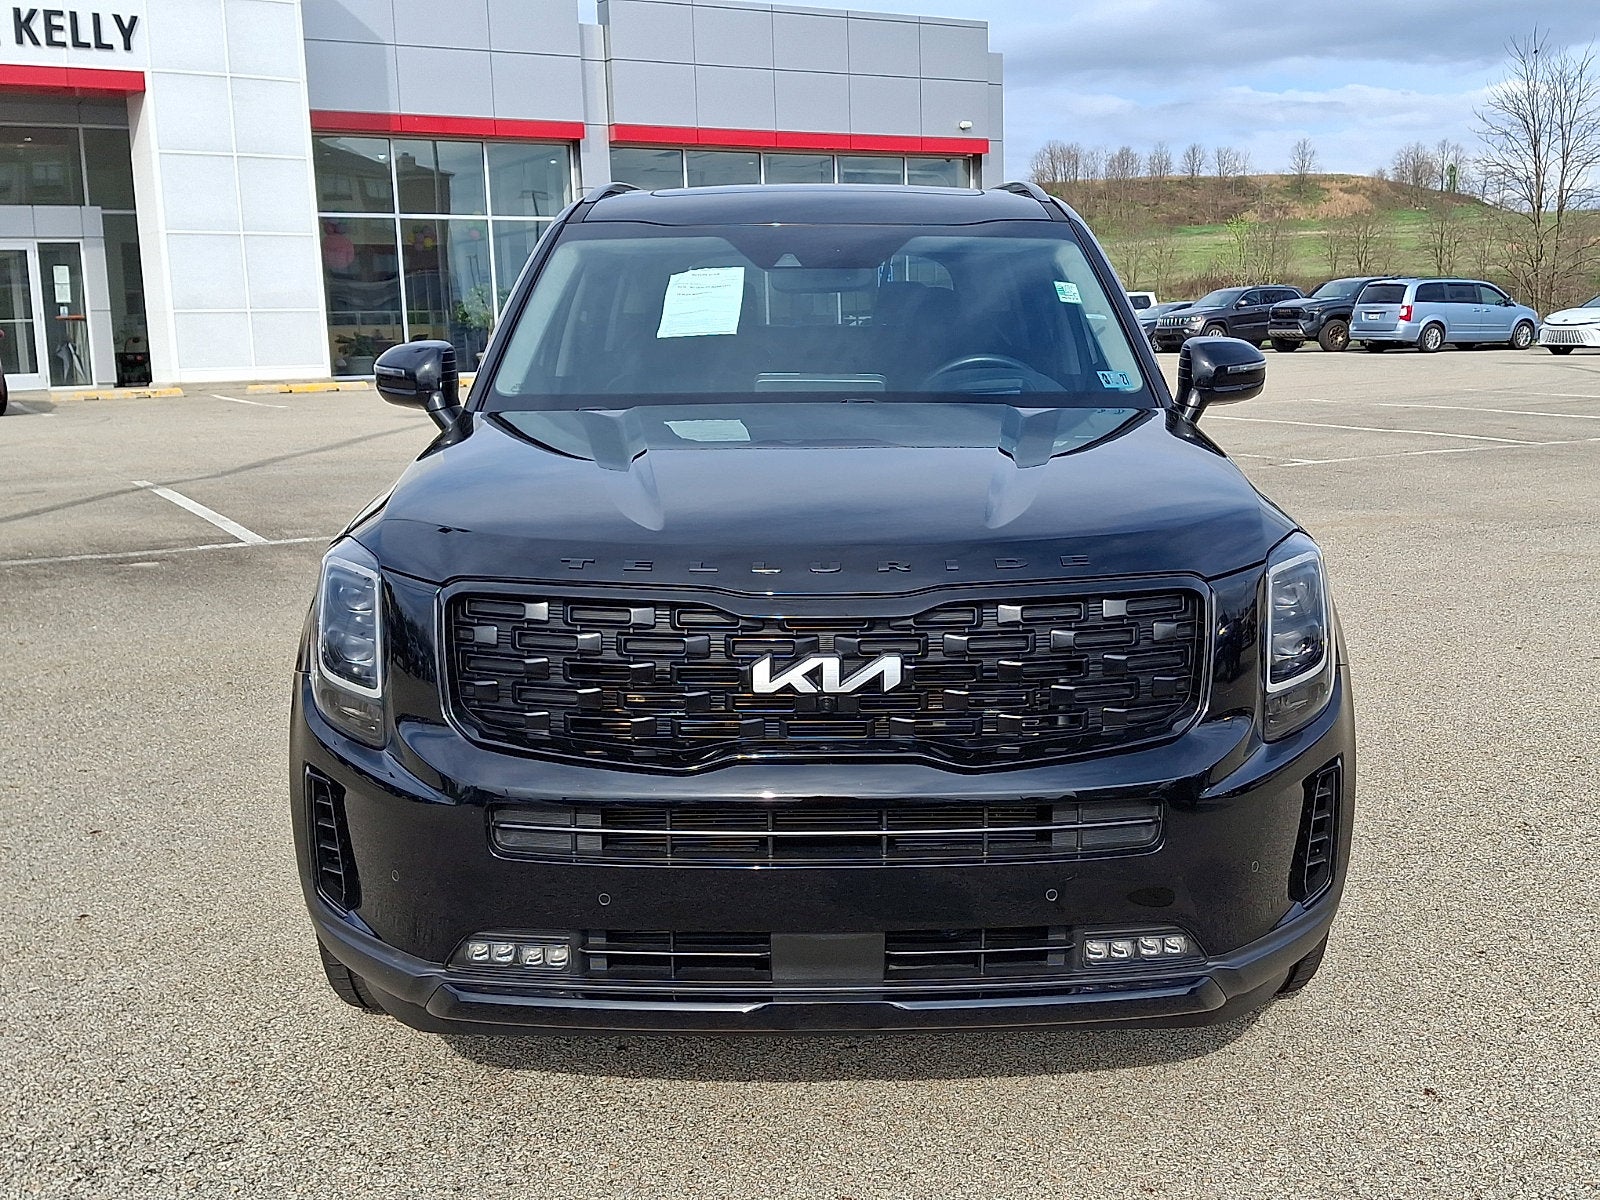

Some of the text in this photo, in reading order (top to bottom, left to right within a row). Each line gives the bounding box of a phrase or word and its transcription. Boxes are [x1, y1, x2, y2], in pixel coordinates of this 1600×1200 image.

[13, 7, 138, 51] KELLY
[559, 554, 1092, 574] TELLURIDE
[752, 655, 902, 693] KIA
